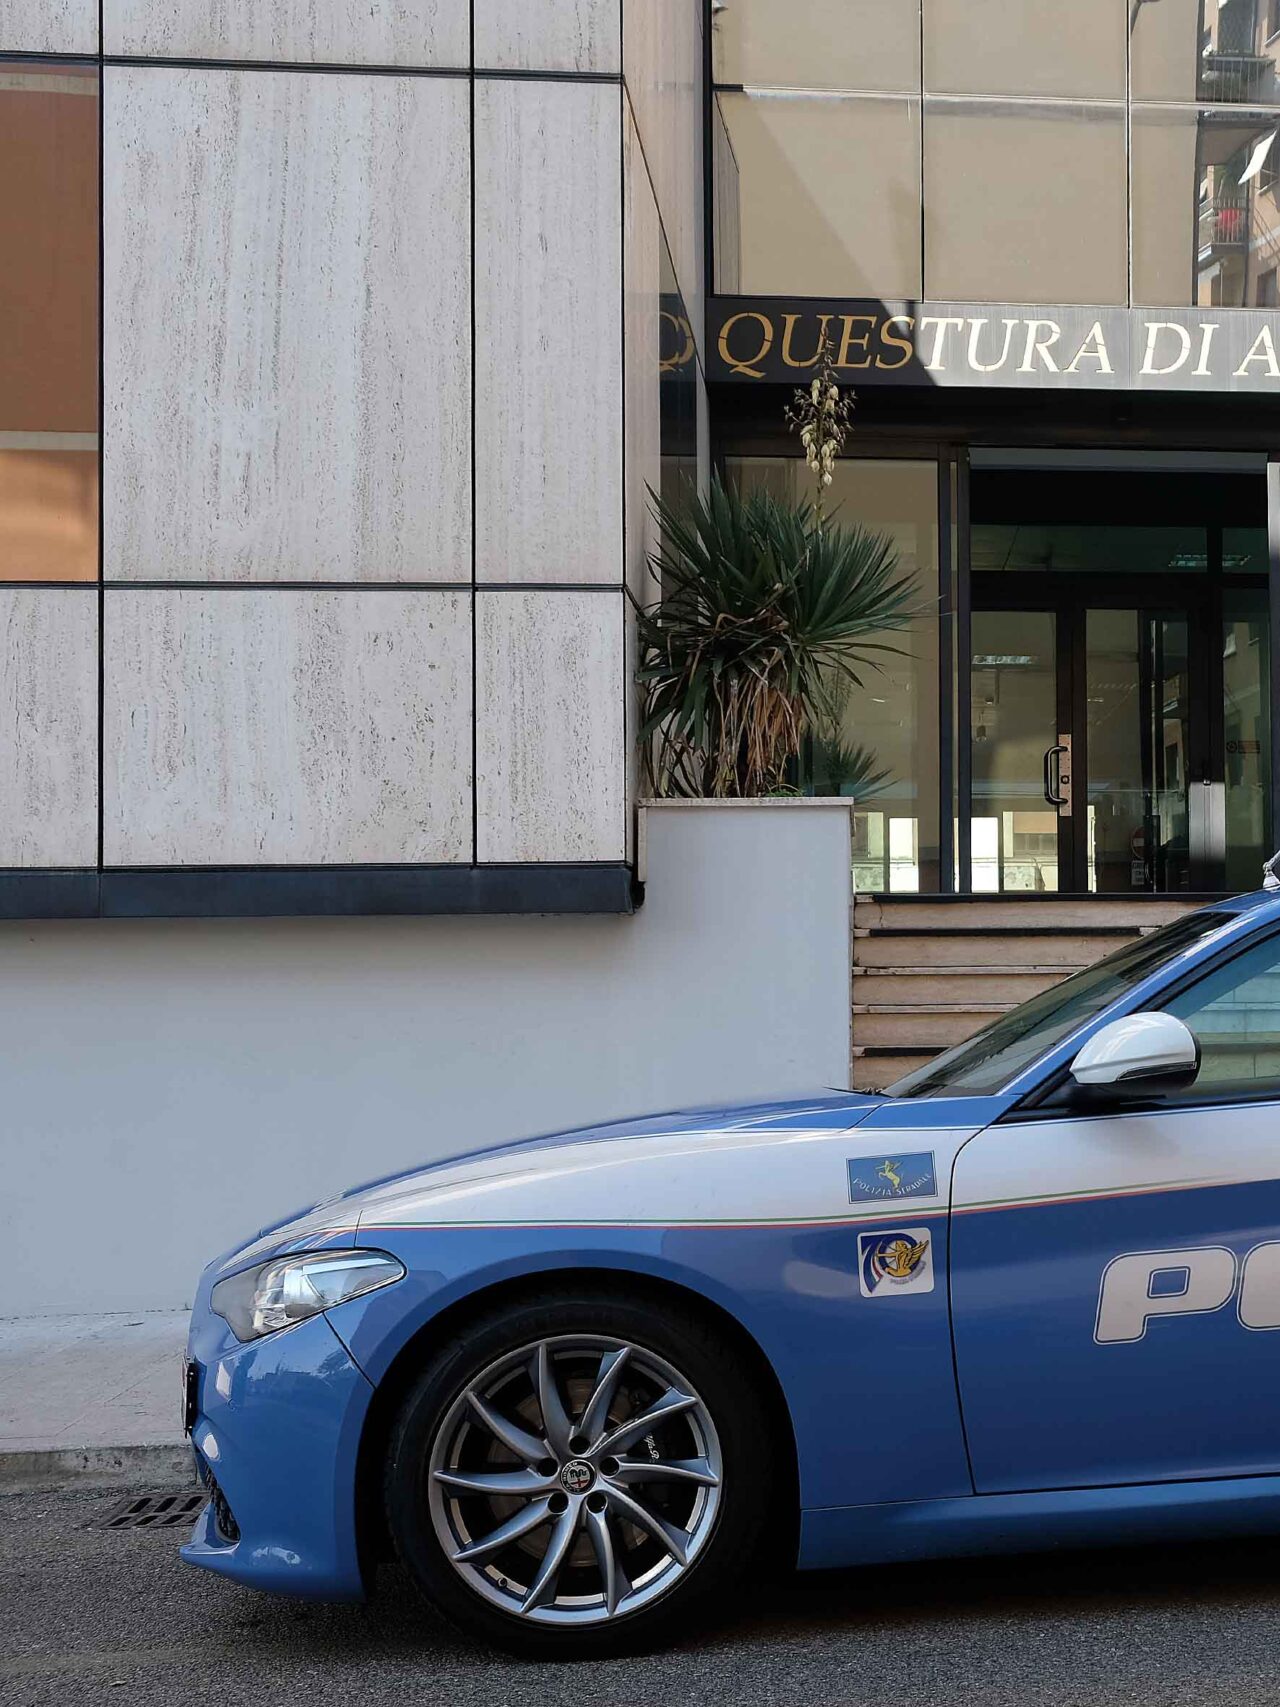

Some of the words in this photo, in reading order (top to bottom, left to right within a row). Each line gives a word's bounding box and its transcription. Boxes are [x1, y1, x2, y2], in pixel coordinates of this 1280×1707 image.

[717, 311, 1115, 379] QUESTURA
[1138, 321, 1221, 376] DI
[853, 1177, 892, 1196] POLIZIA
